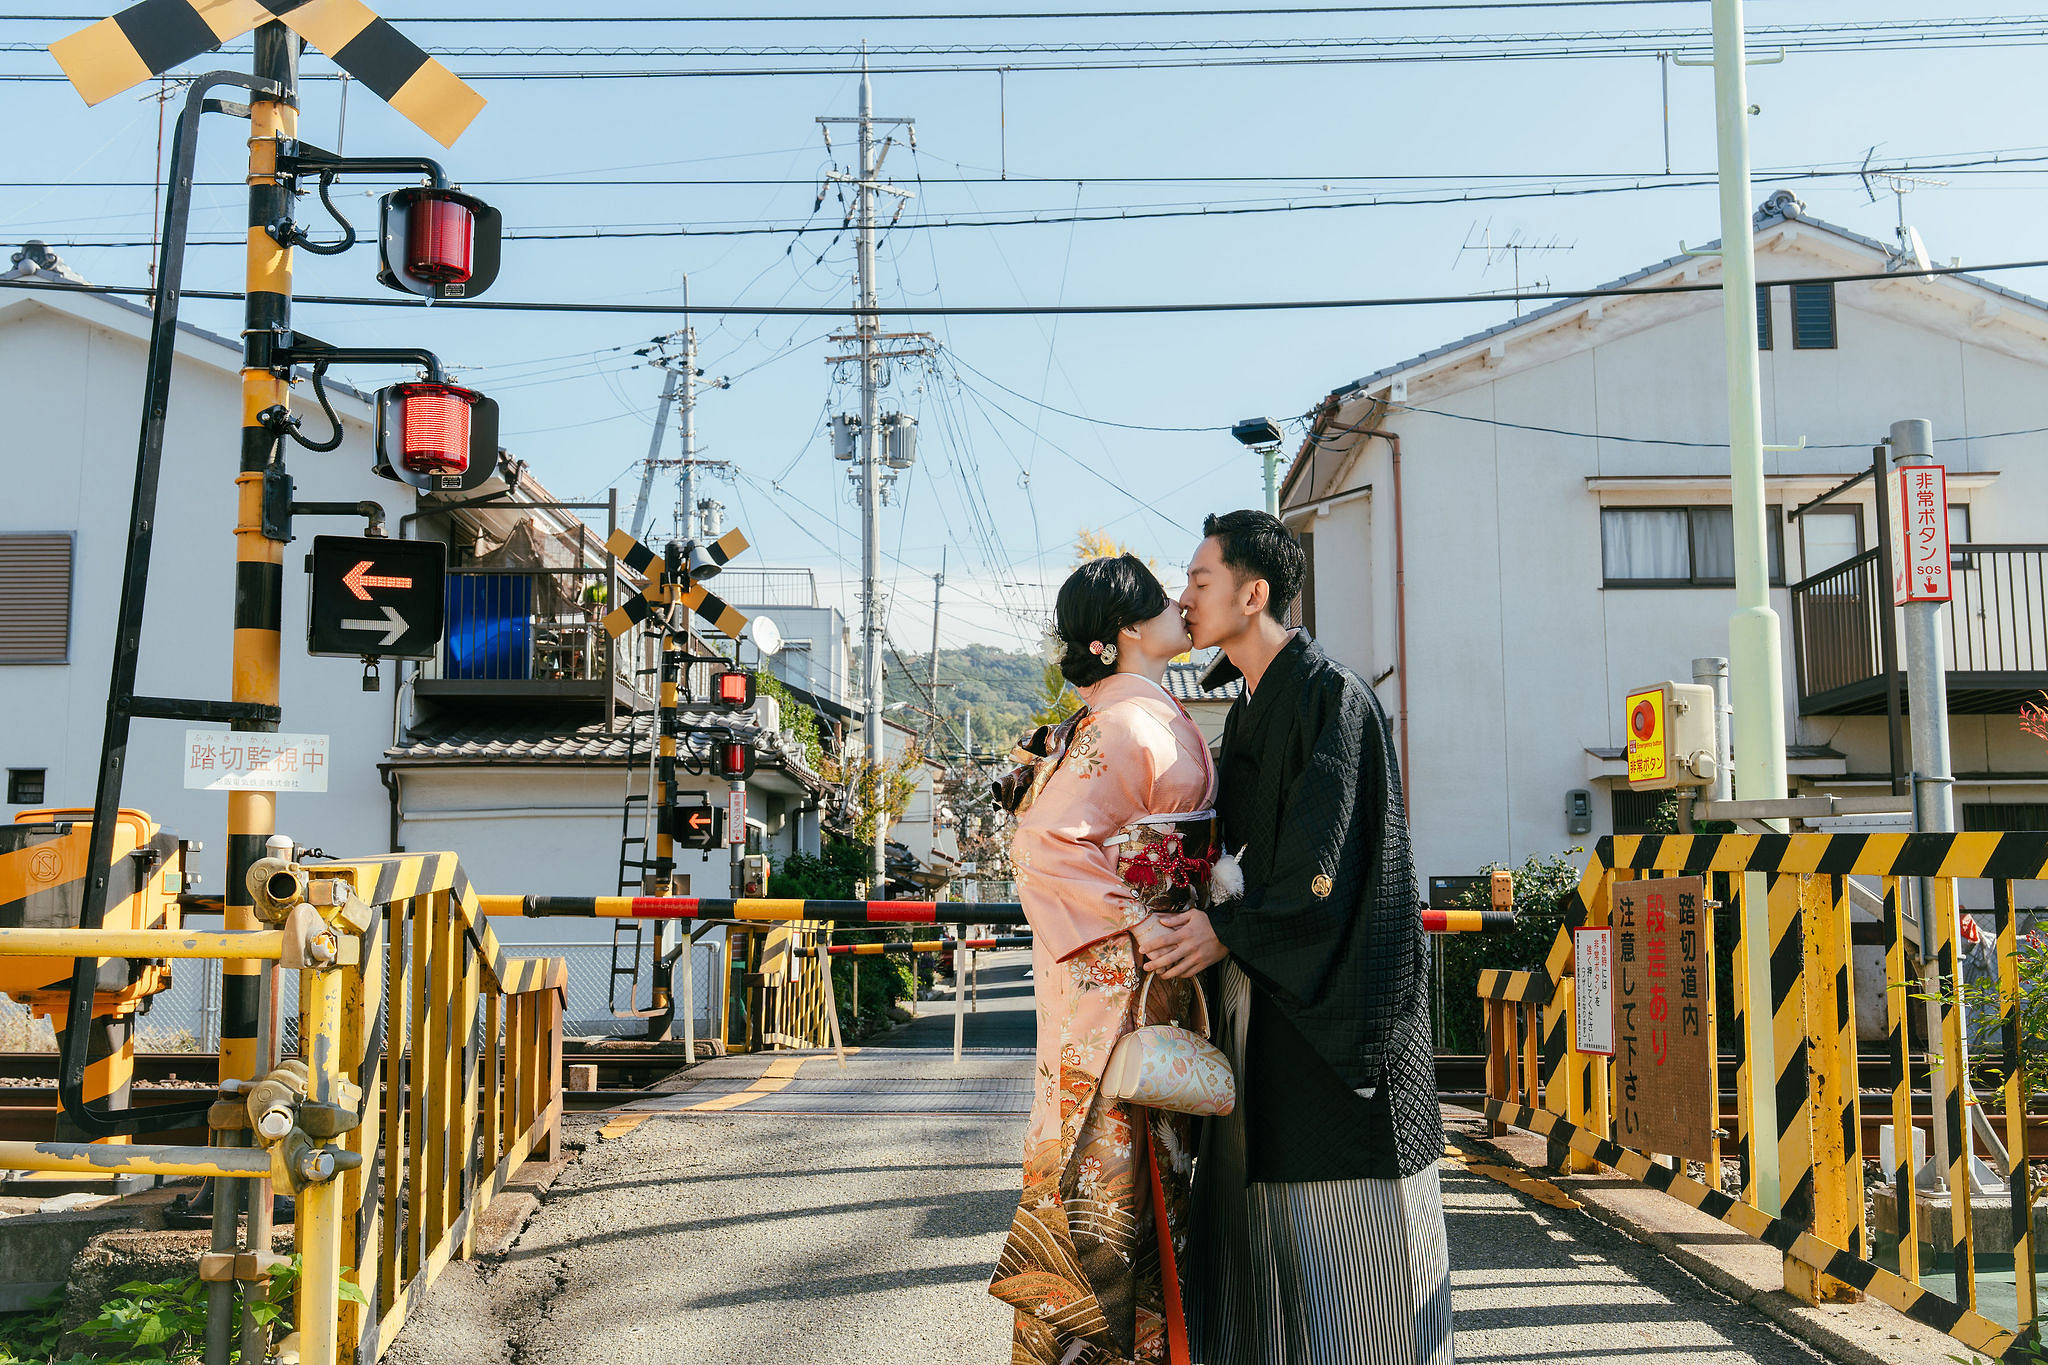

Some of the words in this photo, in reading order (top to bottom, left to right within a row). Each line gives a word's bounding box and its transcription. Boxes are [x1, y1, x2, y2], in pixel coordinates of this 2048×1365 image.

[1916, 472, 1936, 561] 非常ボタン
[1917, 565, 1942, 575] SOS
[190, 743, 324, 773] 踏切監視中
[1629, 757, 1663, 774] 非常ボタン
[1645, 894, 1669, 1066] 段差あり
[1678, 893, 1699, 1036] 踏切道内
[1619, 896, 1639, 1134] 注意して下さい
